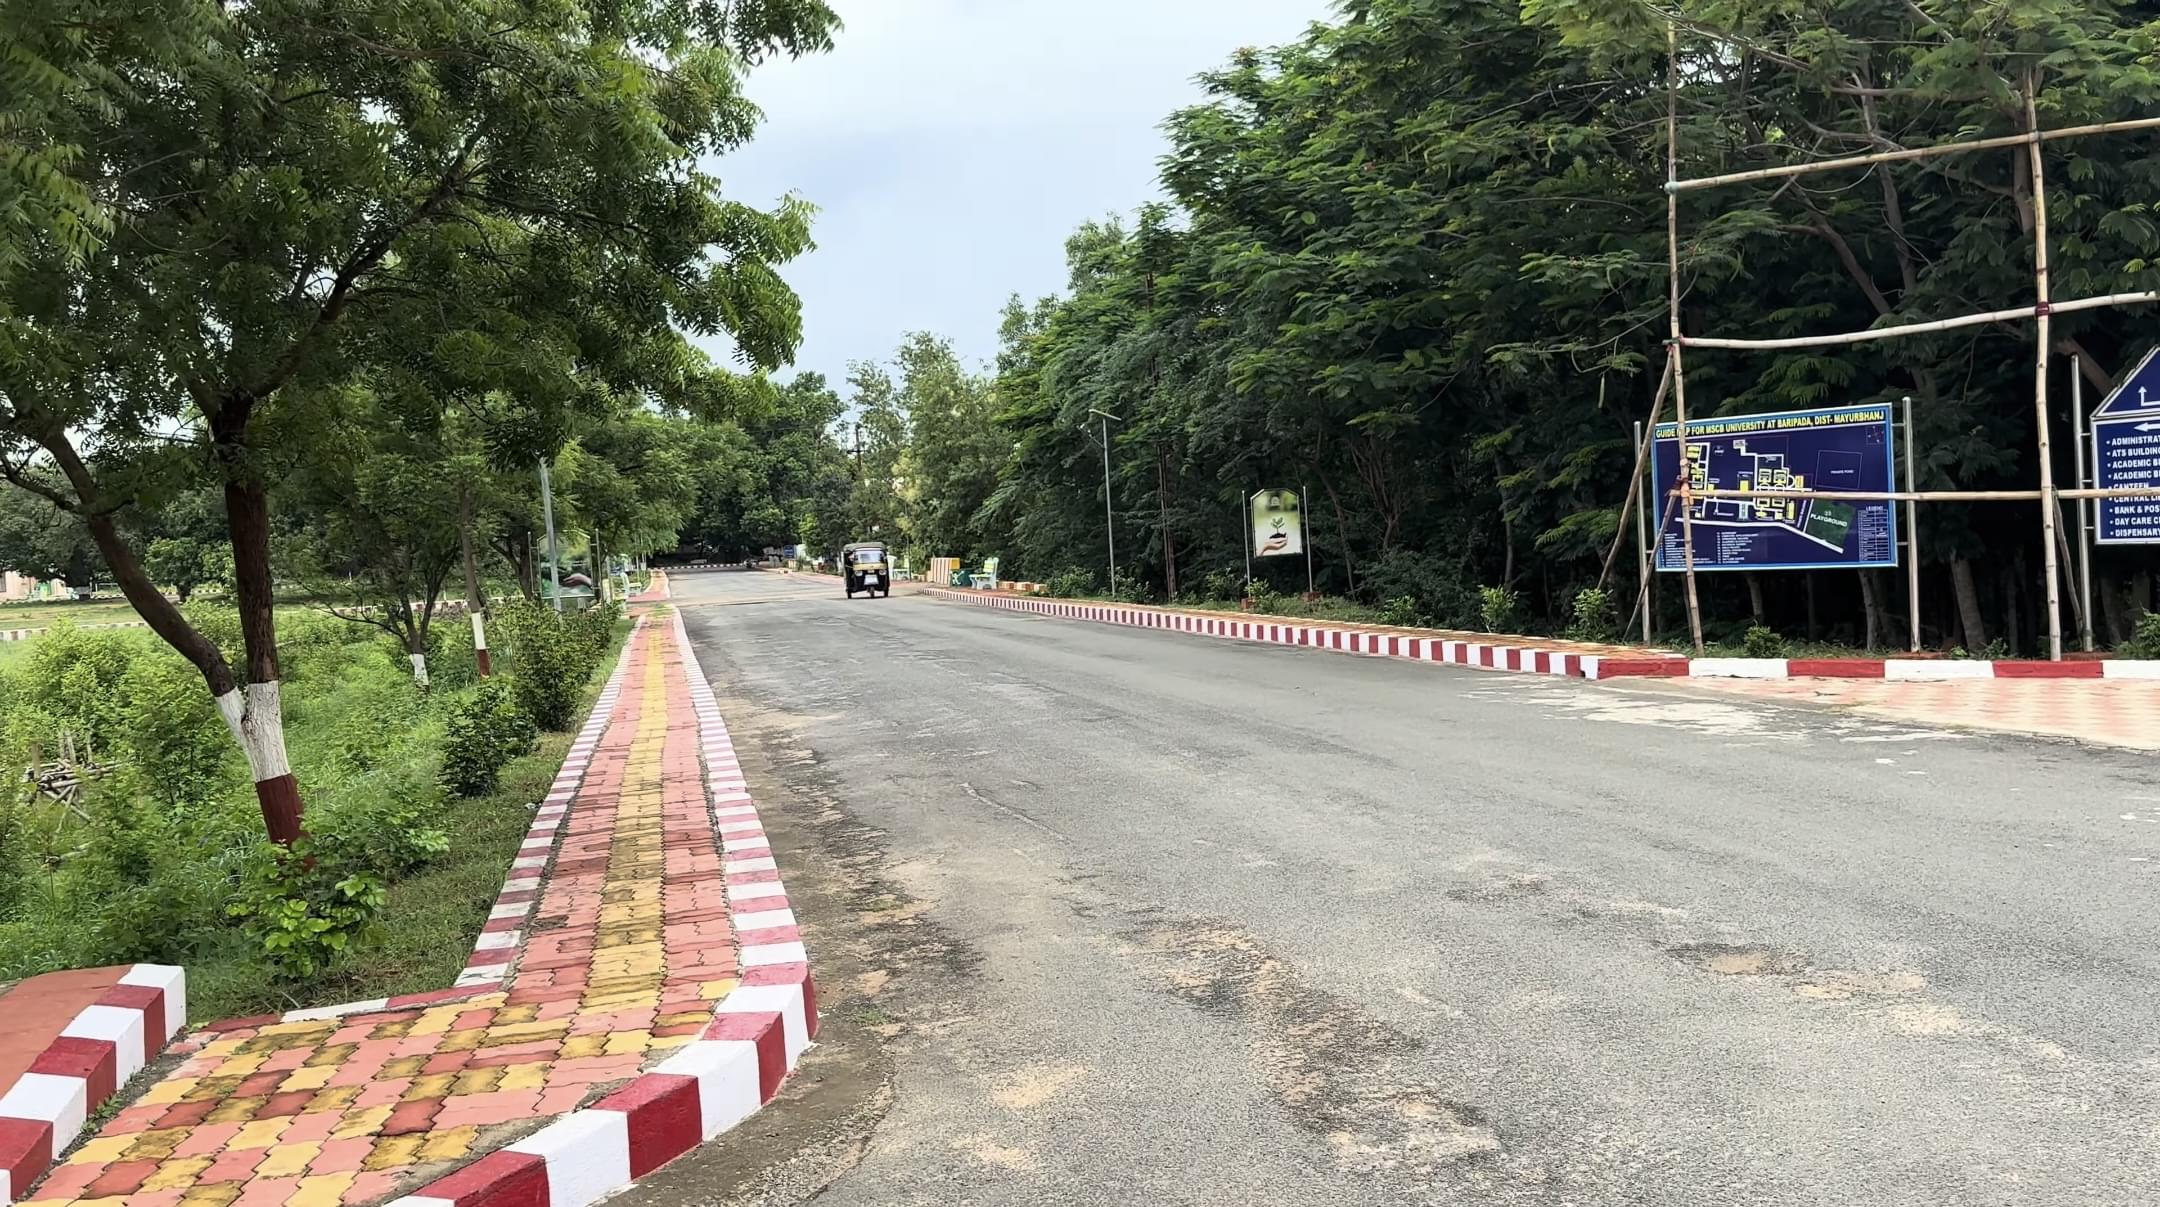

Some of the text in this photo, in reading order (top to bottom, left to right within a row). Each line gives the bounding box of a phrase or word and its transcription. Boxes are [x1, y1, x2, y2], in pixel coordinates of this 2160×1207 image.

[1656, 428, 1676, 438] GUIDE
[1677, 426, 1691, 437] MP
[1691, 426, 1705, 436] FOR
[1725, 420, 1765, 433] UNIVERSITY
[1766, 419, 1776, 429] AT
[1834, 410, 1884, 424] MAYURBHANJ
[2112, 448, 2127, 457] ATS
[2112, 458, 2151, 469] ACADEMIC
[2113, 470, 2152, 480] ACADEMIC
[2114, 505, 2135, 515] BANK
[1810, 513, 1848, 527] PLAYGROUND
[2114, 517, 2130, 526] DAY
[2131, 516, 2152, 525] CARE
